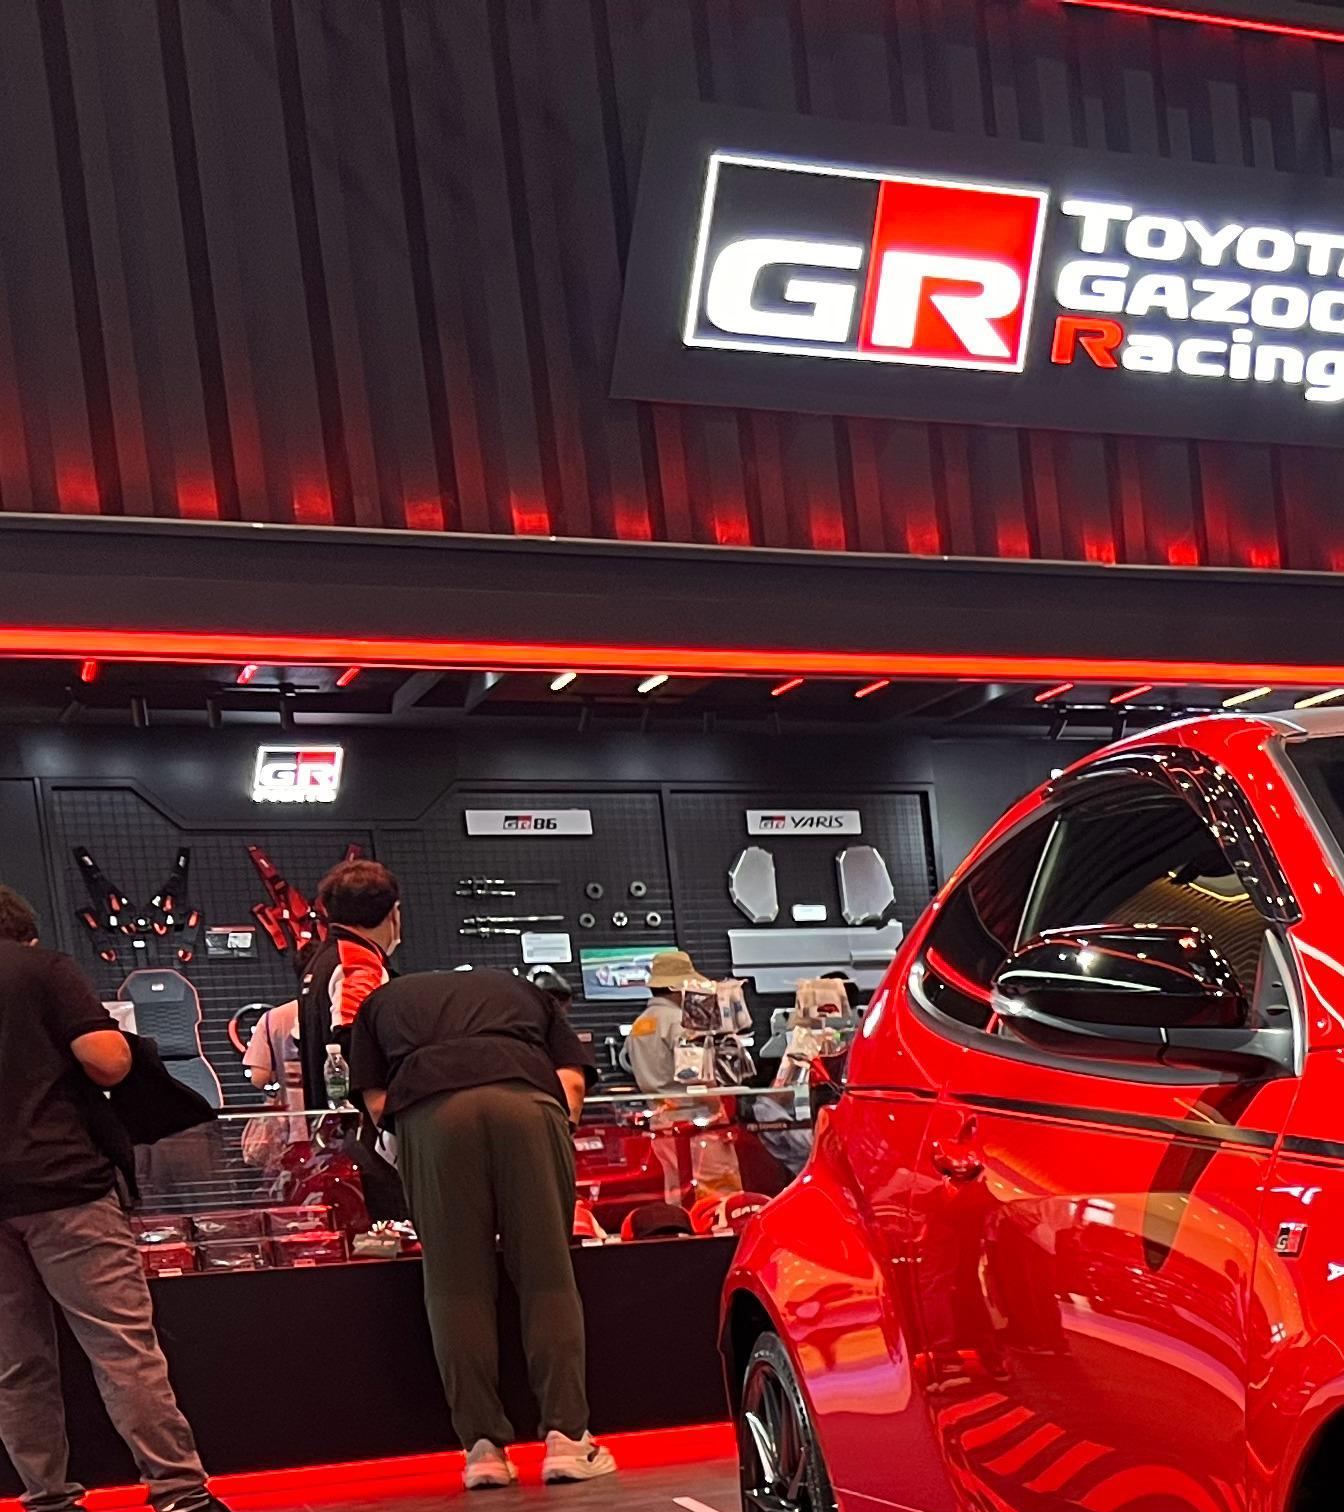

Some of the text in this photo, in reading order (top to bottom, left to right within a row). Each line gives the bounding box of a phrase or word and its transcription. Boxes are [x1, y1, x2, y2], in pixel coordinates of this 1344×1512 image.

[706, 237, 1021, 361] GR
[260, 763, 337, 788] GR
[534, 818, 557, 830] 86
